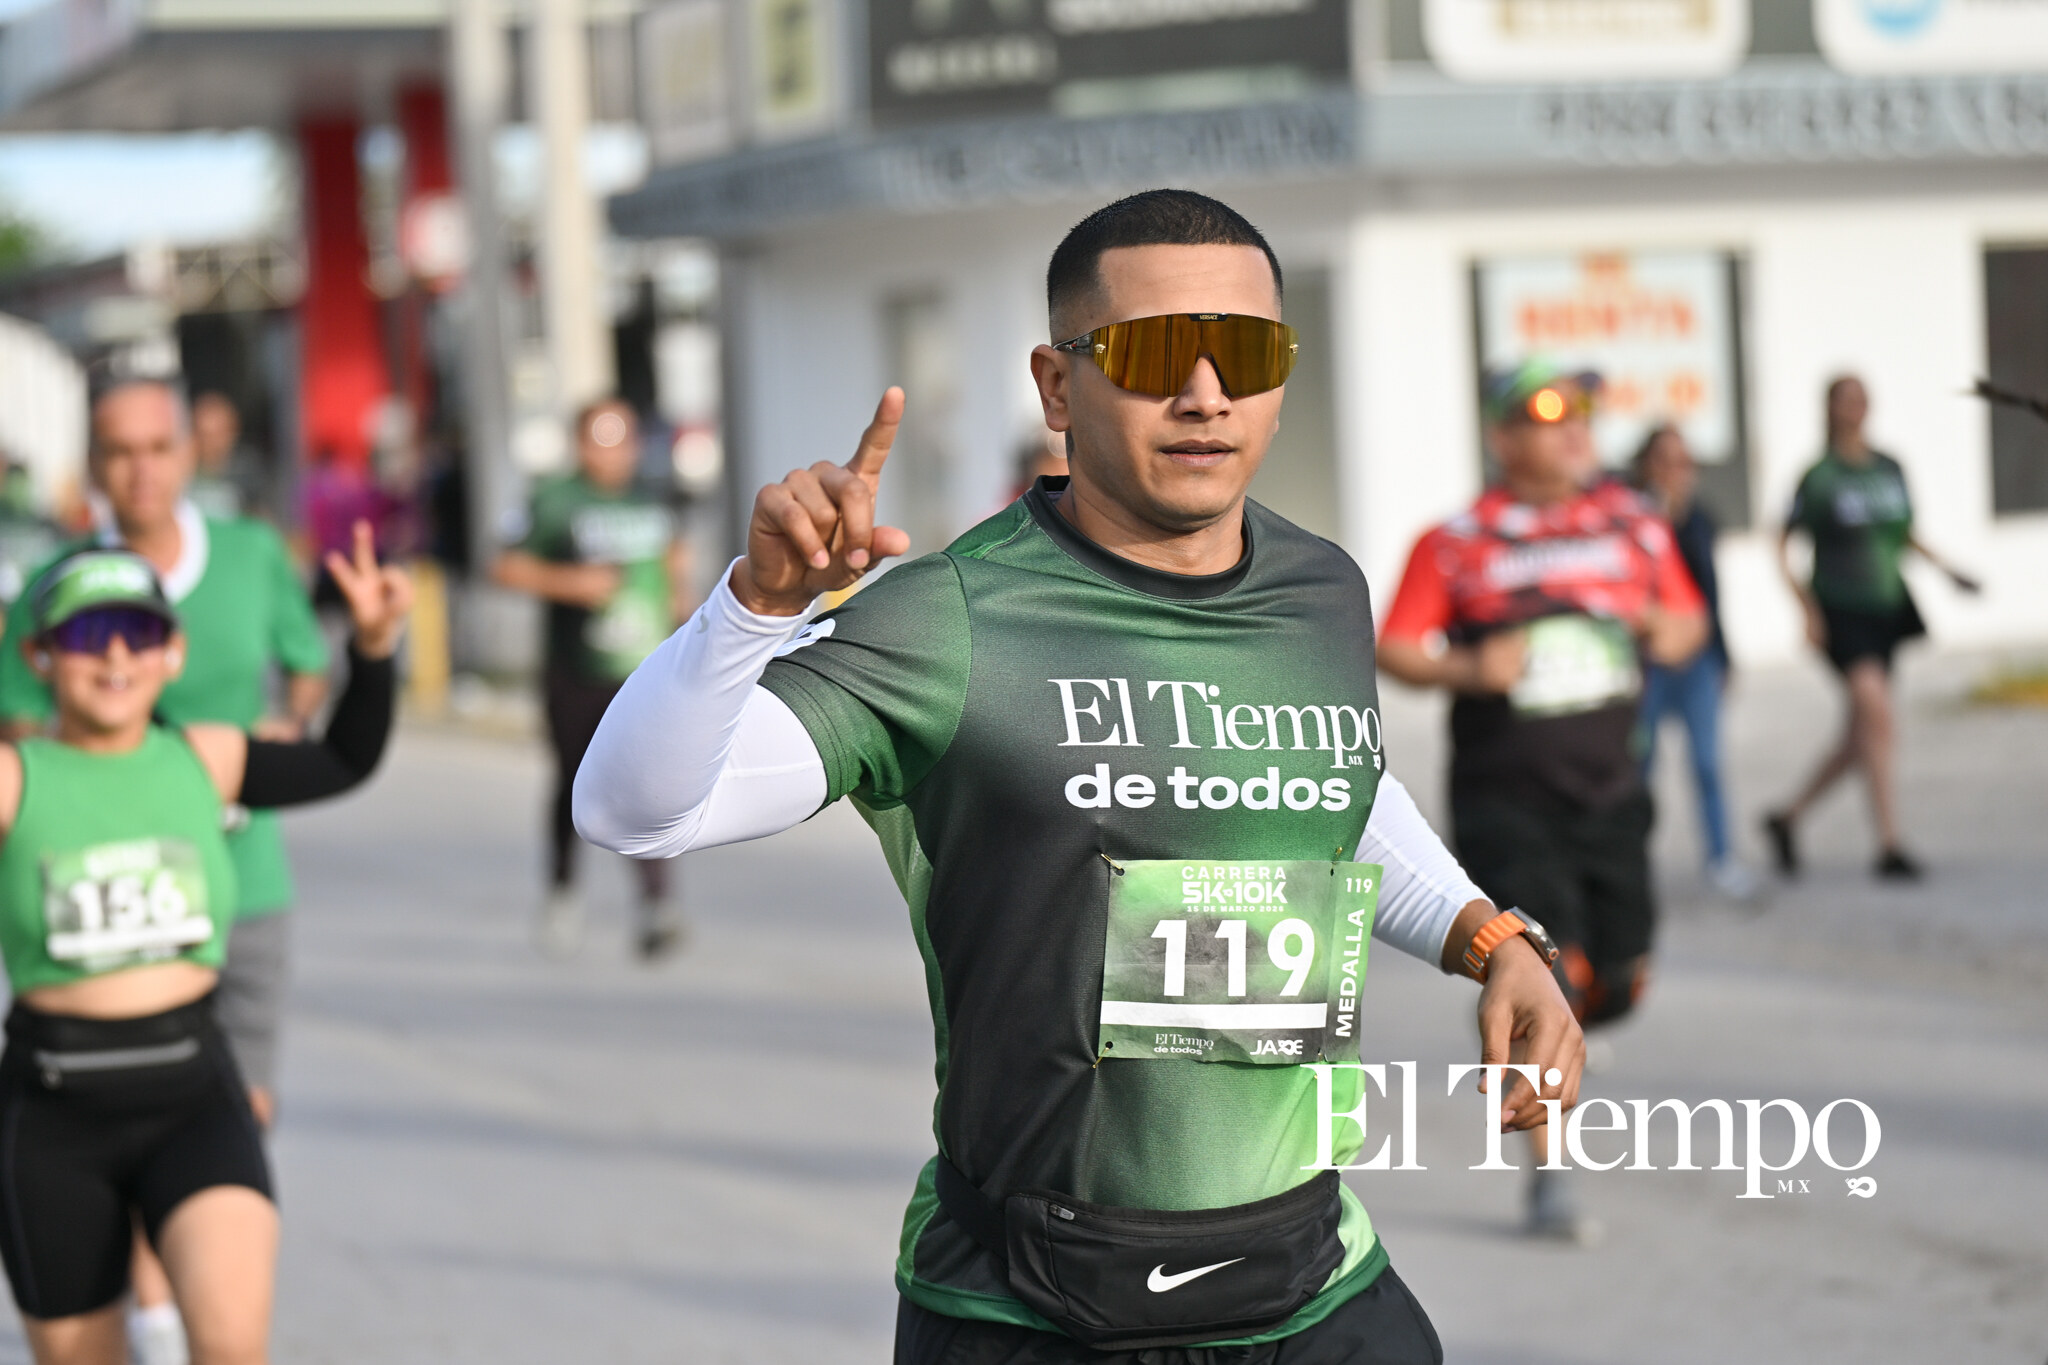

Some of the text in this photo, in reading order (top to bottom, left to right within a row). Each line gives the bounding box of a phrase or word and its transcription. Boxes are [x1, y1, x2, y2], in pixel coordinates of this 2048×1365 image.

[1047, 678, 1381, 769] El Tiempo
[1064, 763, 1351, 811] de todos
[1182, 866, 1287, 880] CARRERA
[1346, 878, 1373, 893] 119
[1150, 918, 1315, 997] 119
[1335, 908, 1365, 1037] MEDALLA
[1154, 1046, 1203, 1056] de todos
[1155, 1033, 1214, 1050] El Tiempo
